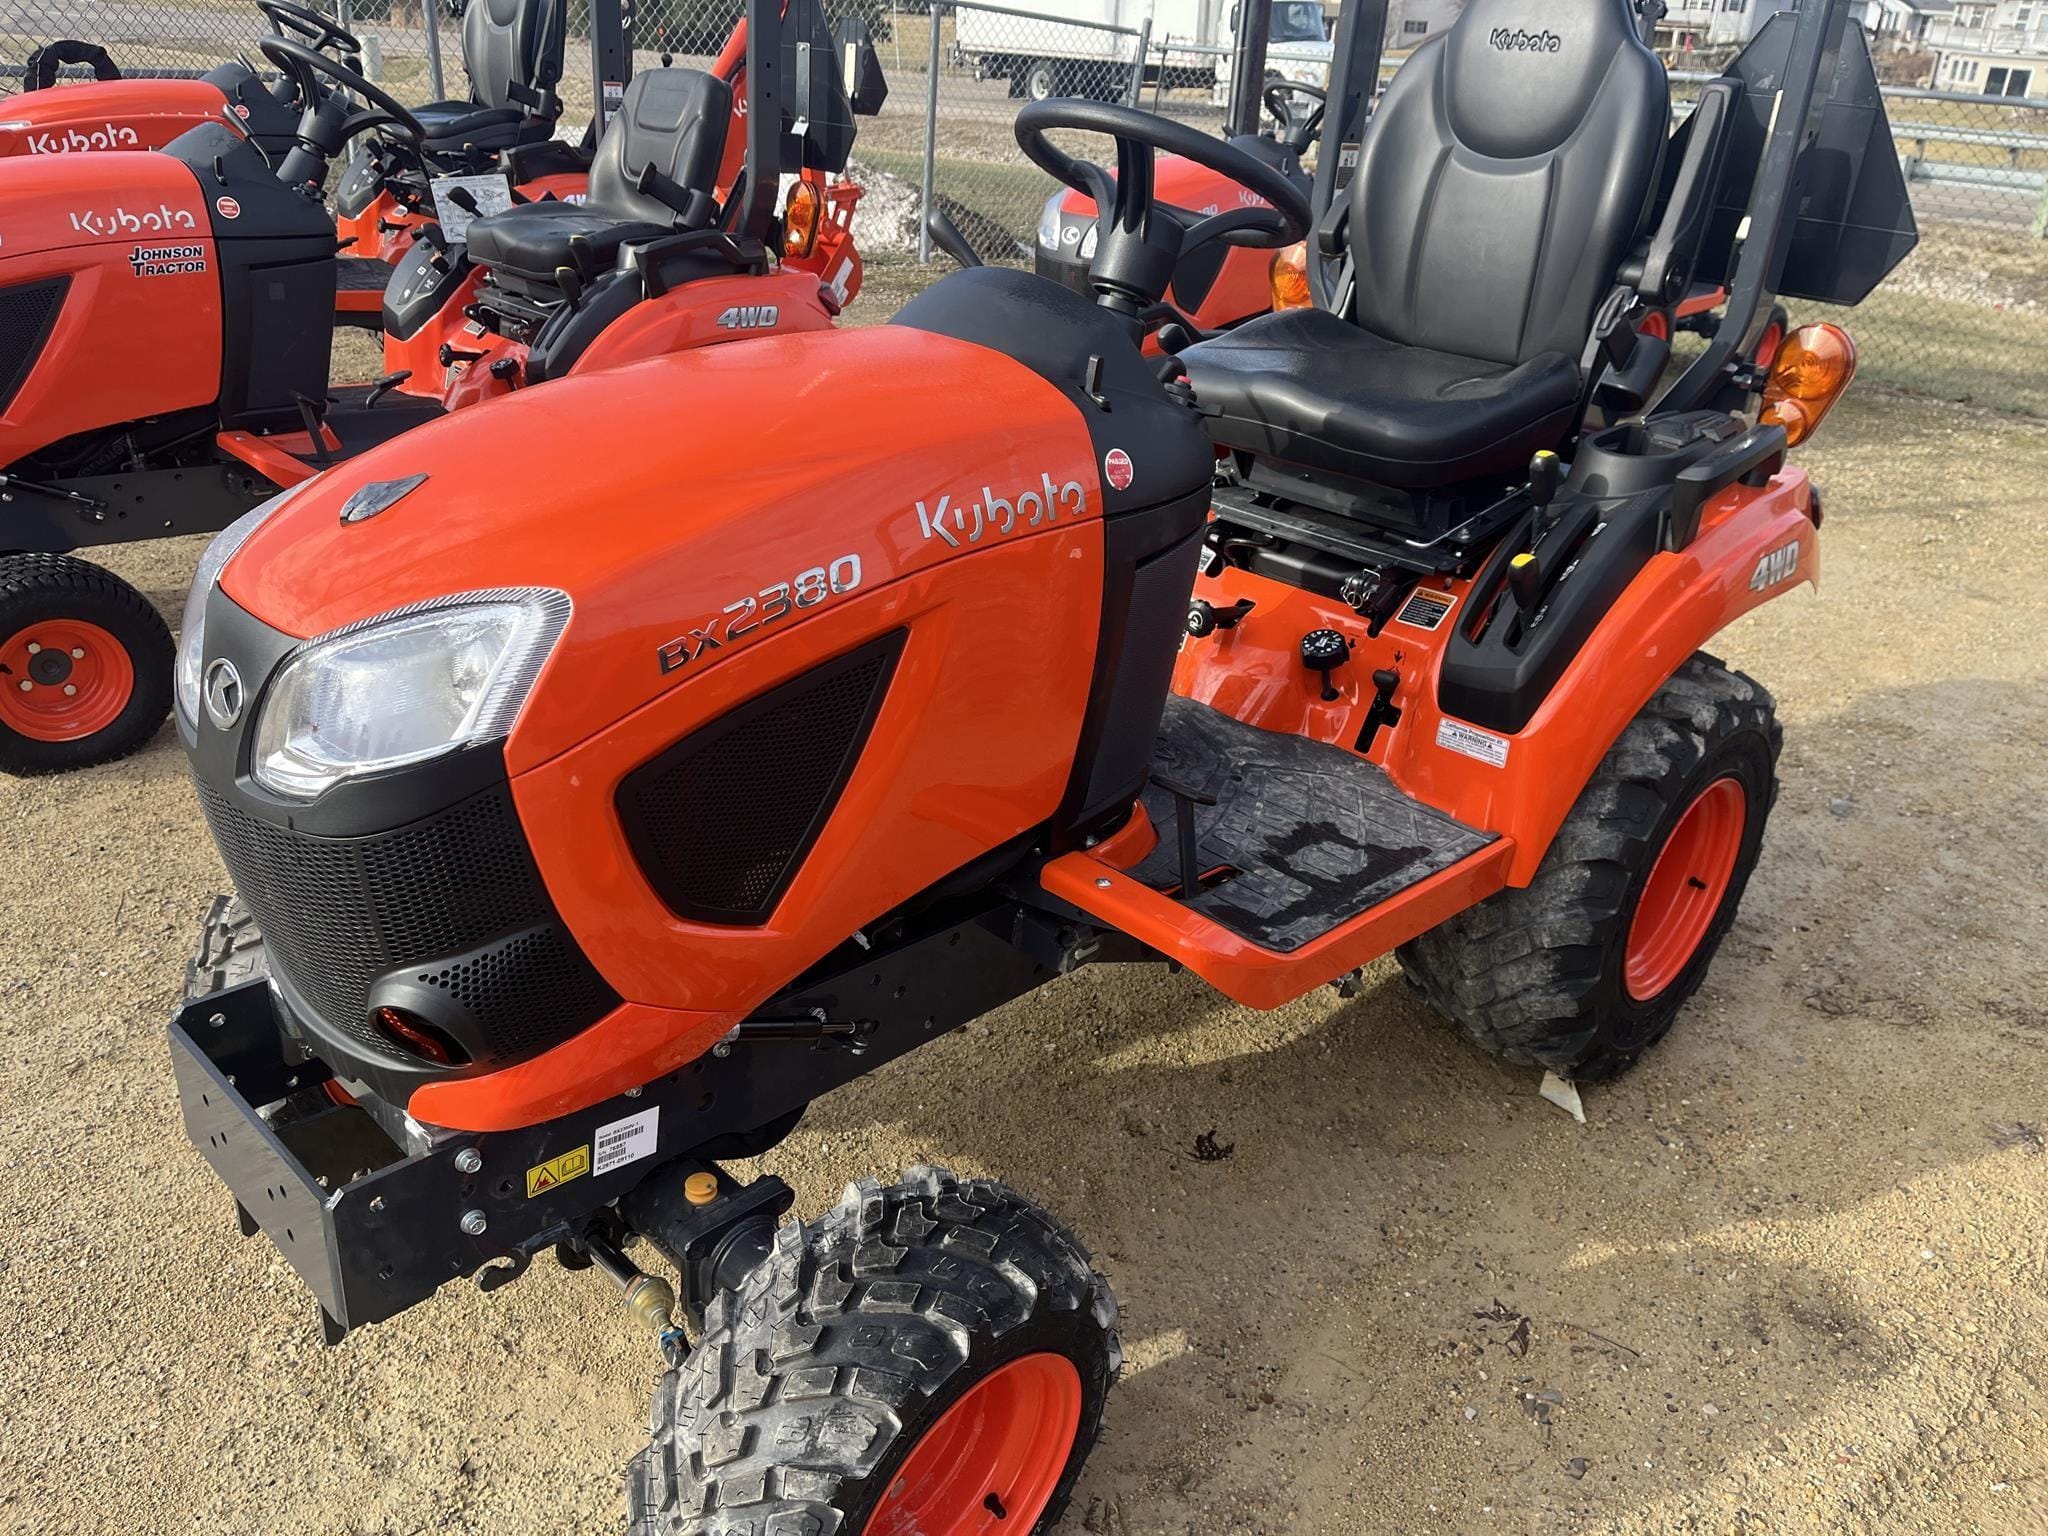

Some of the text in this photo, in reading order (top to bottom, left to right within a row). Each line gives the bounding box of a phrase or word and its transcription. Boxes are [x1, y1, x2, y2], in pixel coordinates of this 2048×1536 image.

[1488, 28, 1561, 53] Kubota
[27, 123, 138, 154] Kubota
[69, 204, 196, 236] Kubota
[128, 245, 204, 262] JOHNSON
[131, 261, 205, 277] TRACTOR
[716, 305, 779, 329] 4WD
[915, 472, 1087, 548] Kubota
[1748, 539, 1799, 592] 4WD
[656, 553, 863, 676] BX2380
[1458, 731, 1488, 747] WARNING
